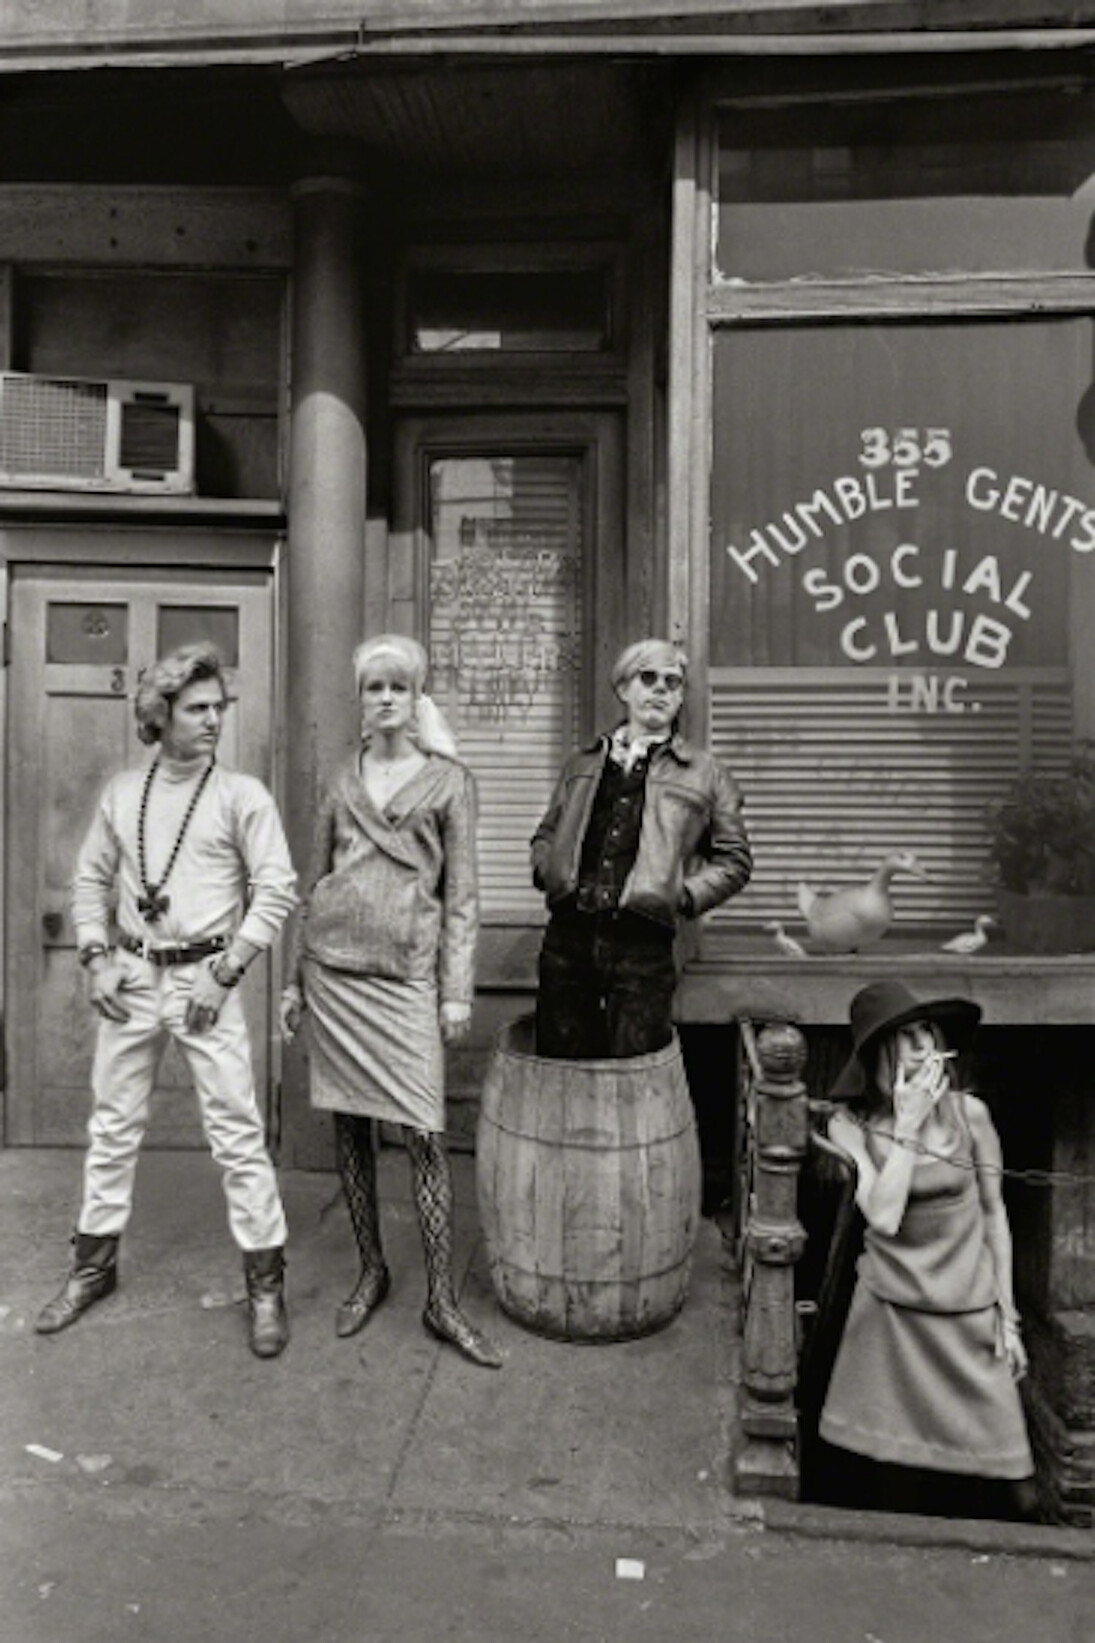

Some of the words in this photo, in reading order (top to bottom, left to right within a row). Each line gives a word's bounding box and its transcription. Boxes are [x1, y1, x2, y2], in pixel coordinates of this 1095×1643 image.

[858, 426, 952, 467] 355
[727, 468, 919, 584] HUMBLE
[966, 466, 1095, 552] GENTS
[803, 543, 1032, 620] SOCIAL
[840, 609, 1012, 669] CLUB
[887, 674, 982, 714] INC.
